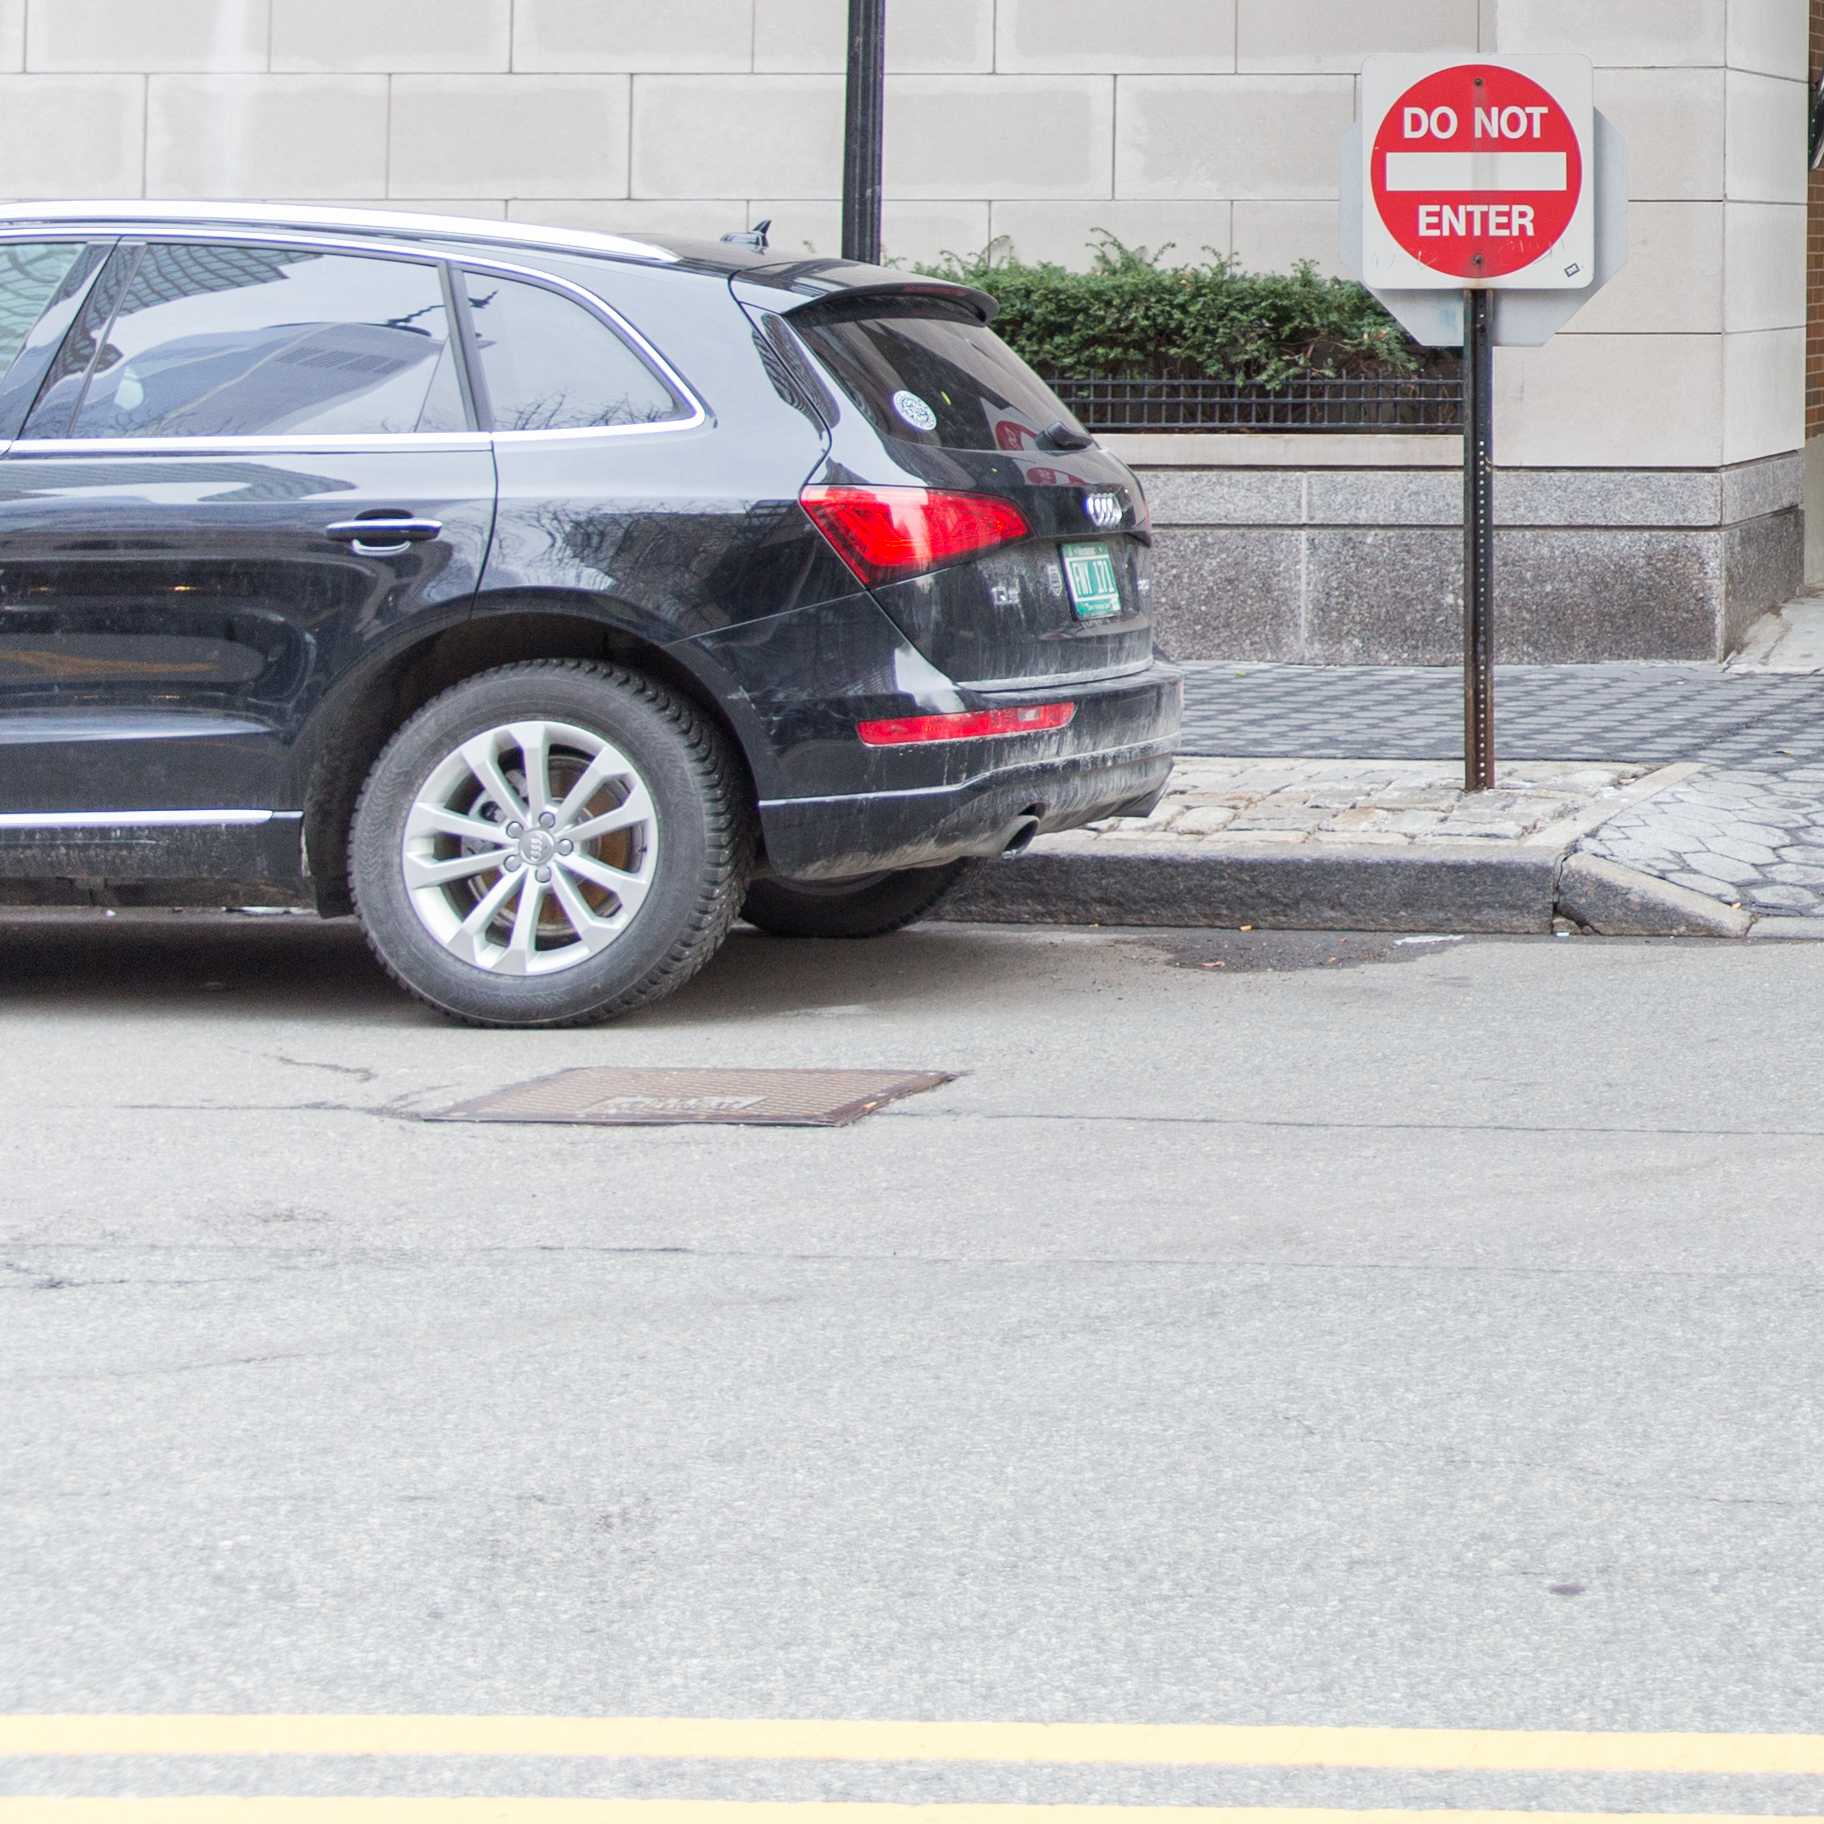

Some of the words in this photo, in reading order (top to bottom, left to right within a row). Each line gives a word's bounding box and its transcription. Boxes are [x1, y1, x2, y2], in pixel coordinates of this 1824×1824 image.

[1402, 106, 1458, 139] DO
[1474, 106, 1549, 139] NOT
[1418, 204, 1535, 237] ENTER
